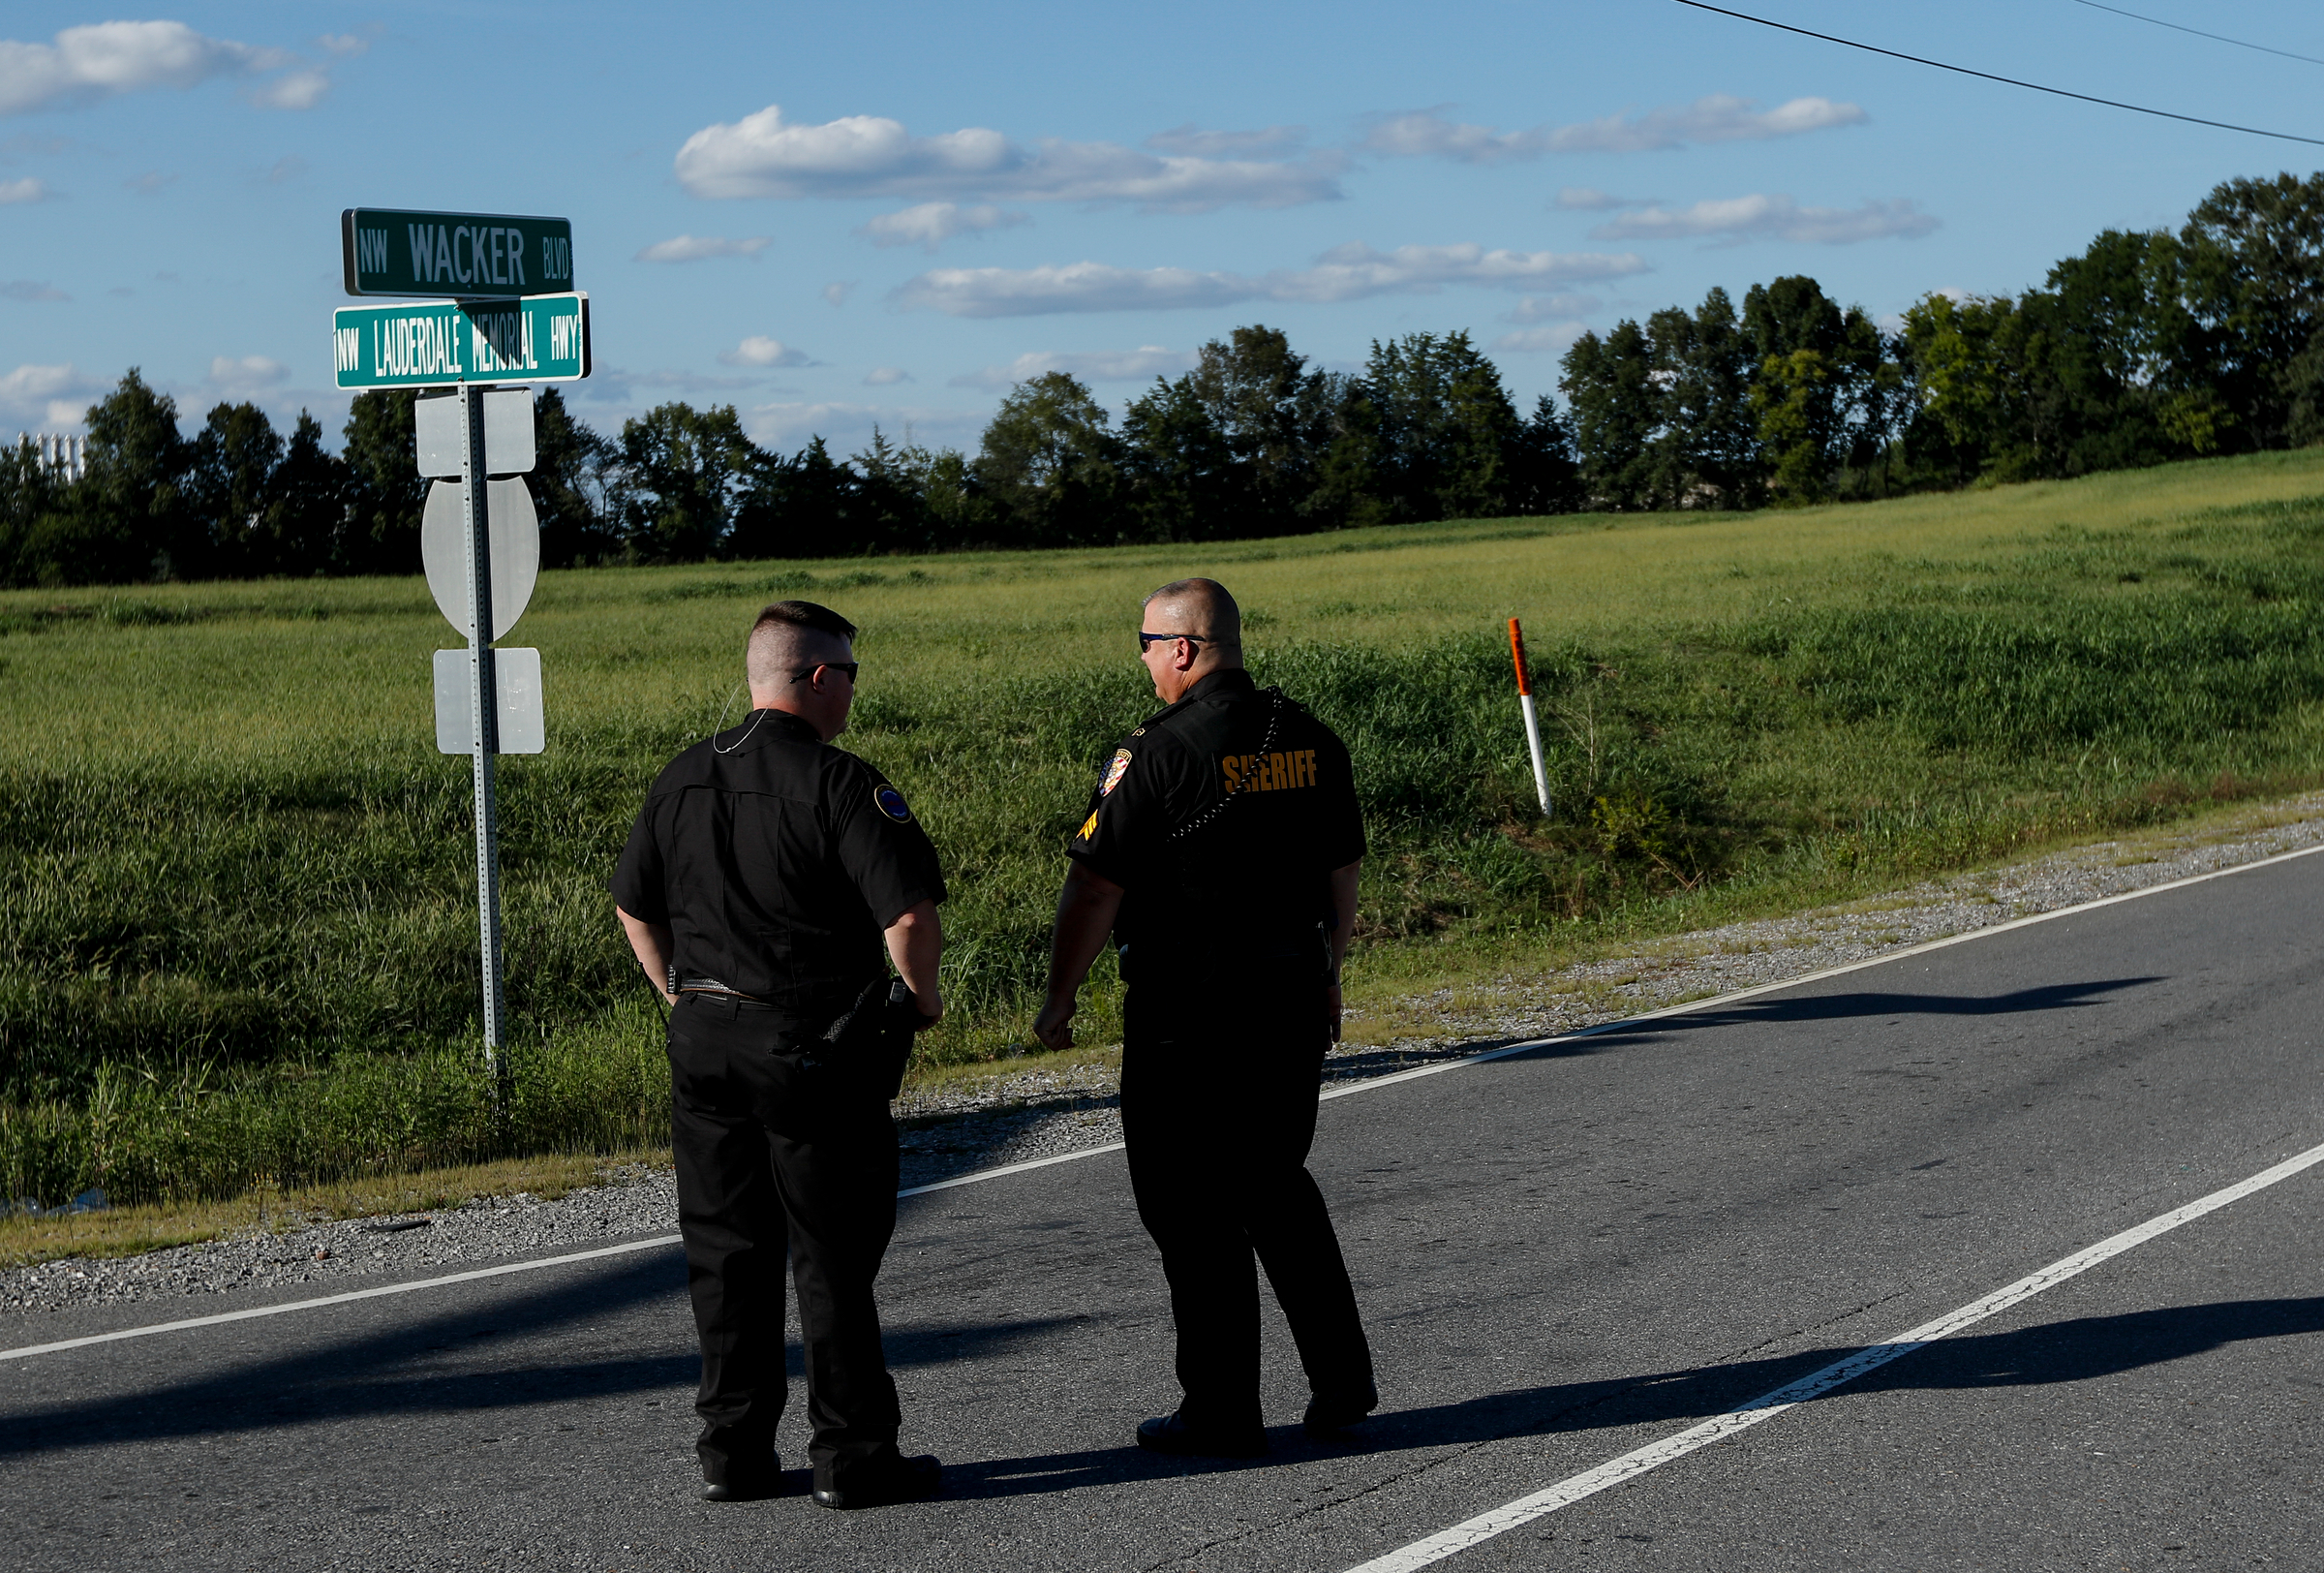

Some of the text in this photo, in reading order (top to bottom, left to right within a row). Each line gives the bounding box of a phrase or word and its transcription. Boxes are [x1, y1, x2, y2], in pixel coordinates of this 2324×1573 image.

[359, 229, 388, 273] NW
[408, 223, 526, 286] WACKER
[542, 236, 569, 280] BLVD
[336, 326, 359, 372] NW
[373, 315, 463, 377] LAUDERDALE
[472, 310, 538, 373] MEMORIAL
[550, 314, 579, 361] HWY
[1222, 749, 1317, 794] SHERIFF
